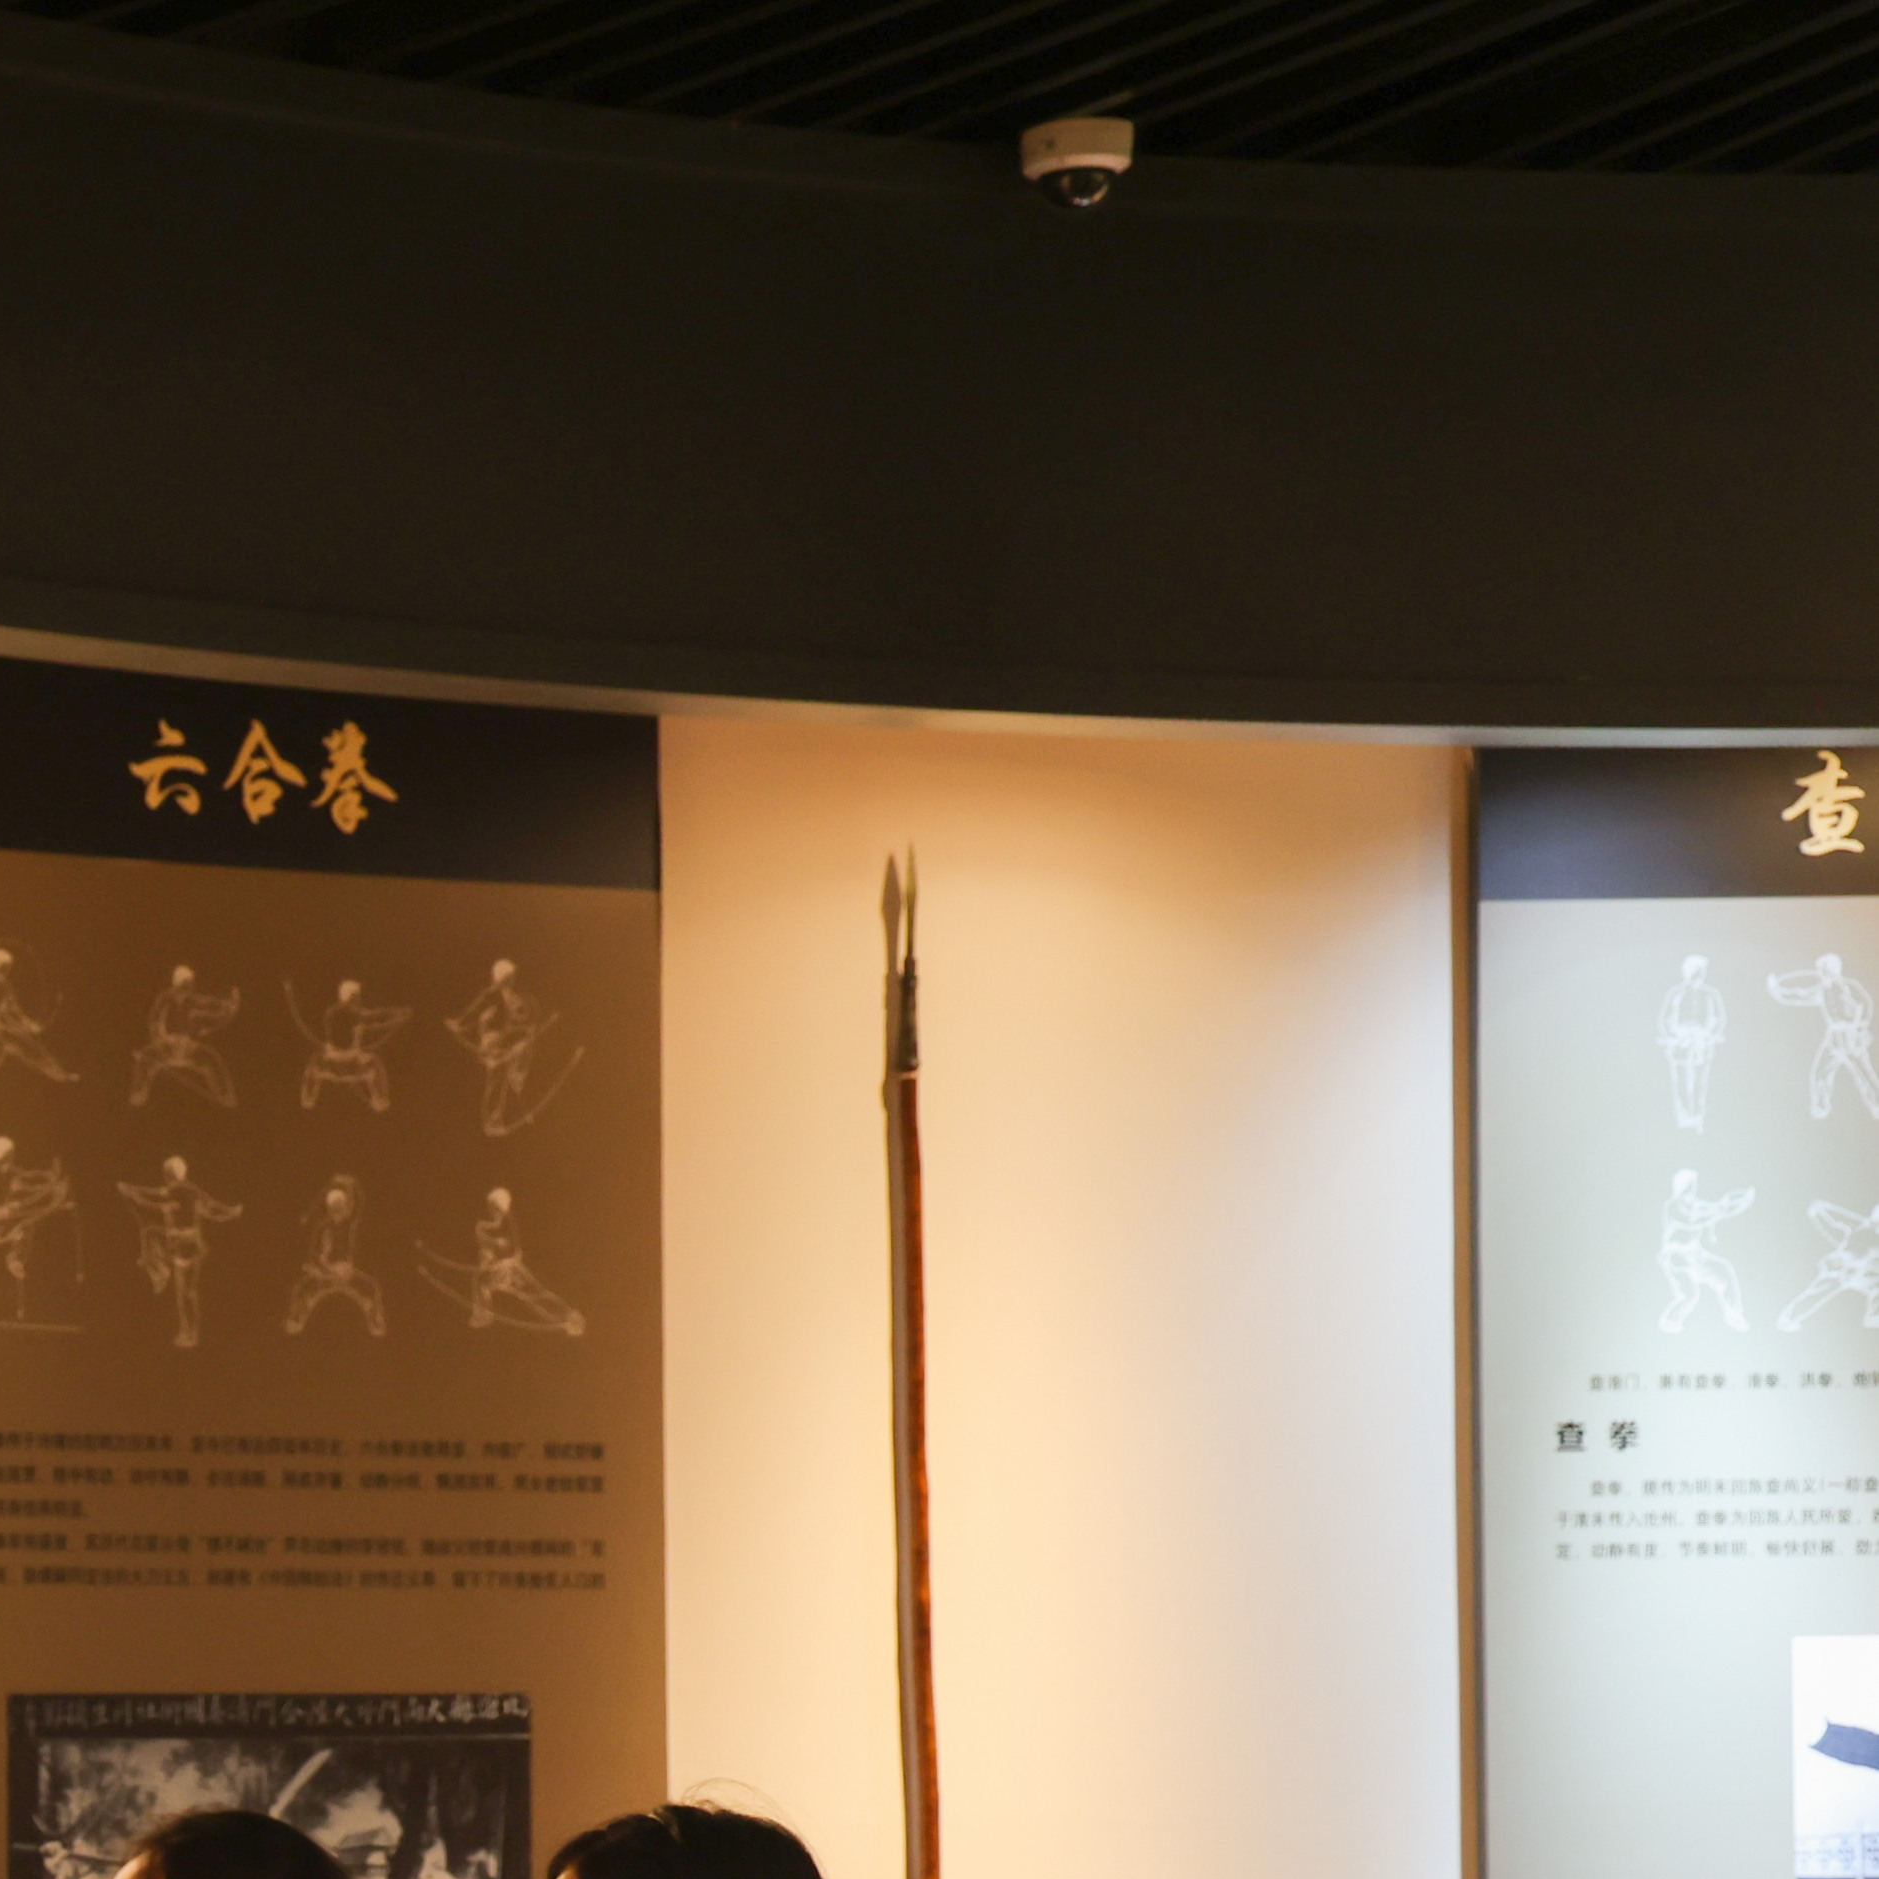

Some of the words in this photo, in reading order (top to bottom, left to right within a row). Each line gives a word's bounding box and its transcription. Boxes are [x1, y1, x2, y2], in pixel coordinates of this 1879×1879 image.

[128, 719, 398, 833] 六合拳
[1781, 750, 1866, 856] 查
